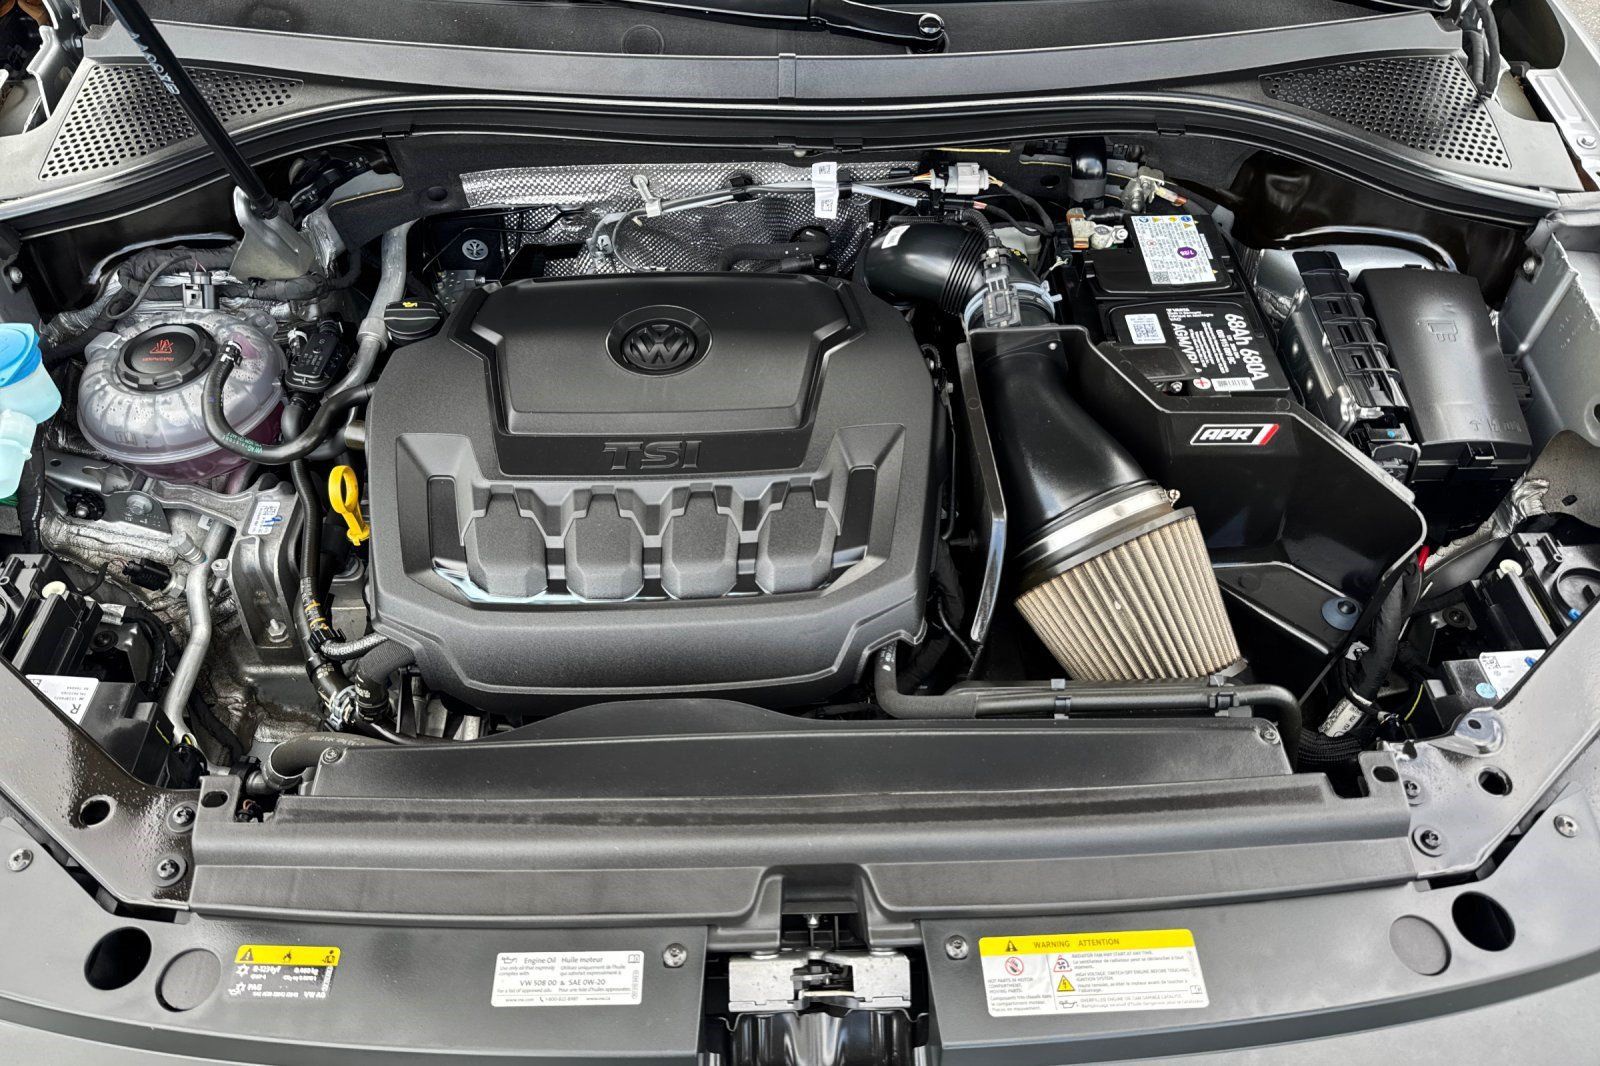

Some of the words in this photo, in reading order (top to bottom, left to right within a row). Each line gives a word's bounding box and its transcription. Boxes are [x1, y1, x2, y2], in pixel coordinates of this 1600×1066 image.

[1225, 313, 1253, 346] 68Ah
[1239, 348, 1269, 381] 680A
[1200, 429, 1253, 440] APR
[602, 440, 702, 470] TSI
[70, 703, 82, 715] R
[1034, 940, 1070, 949] WARNING
[1078, 938, 1120, 947] ATTENTION
[524, 957, 546, 965] Engine
